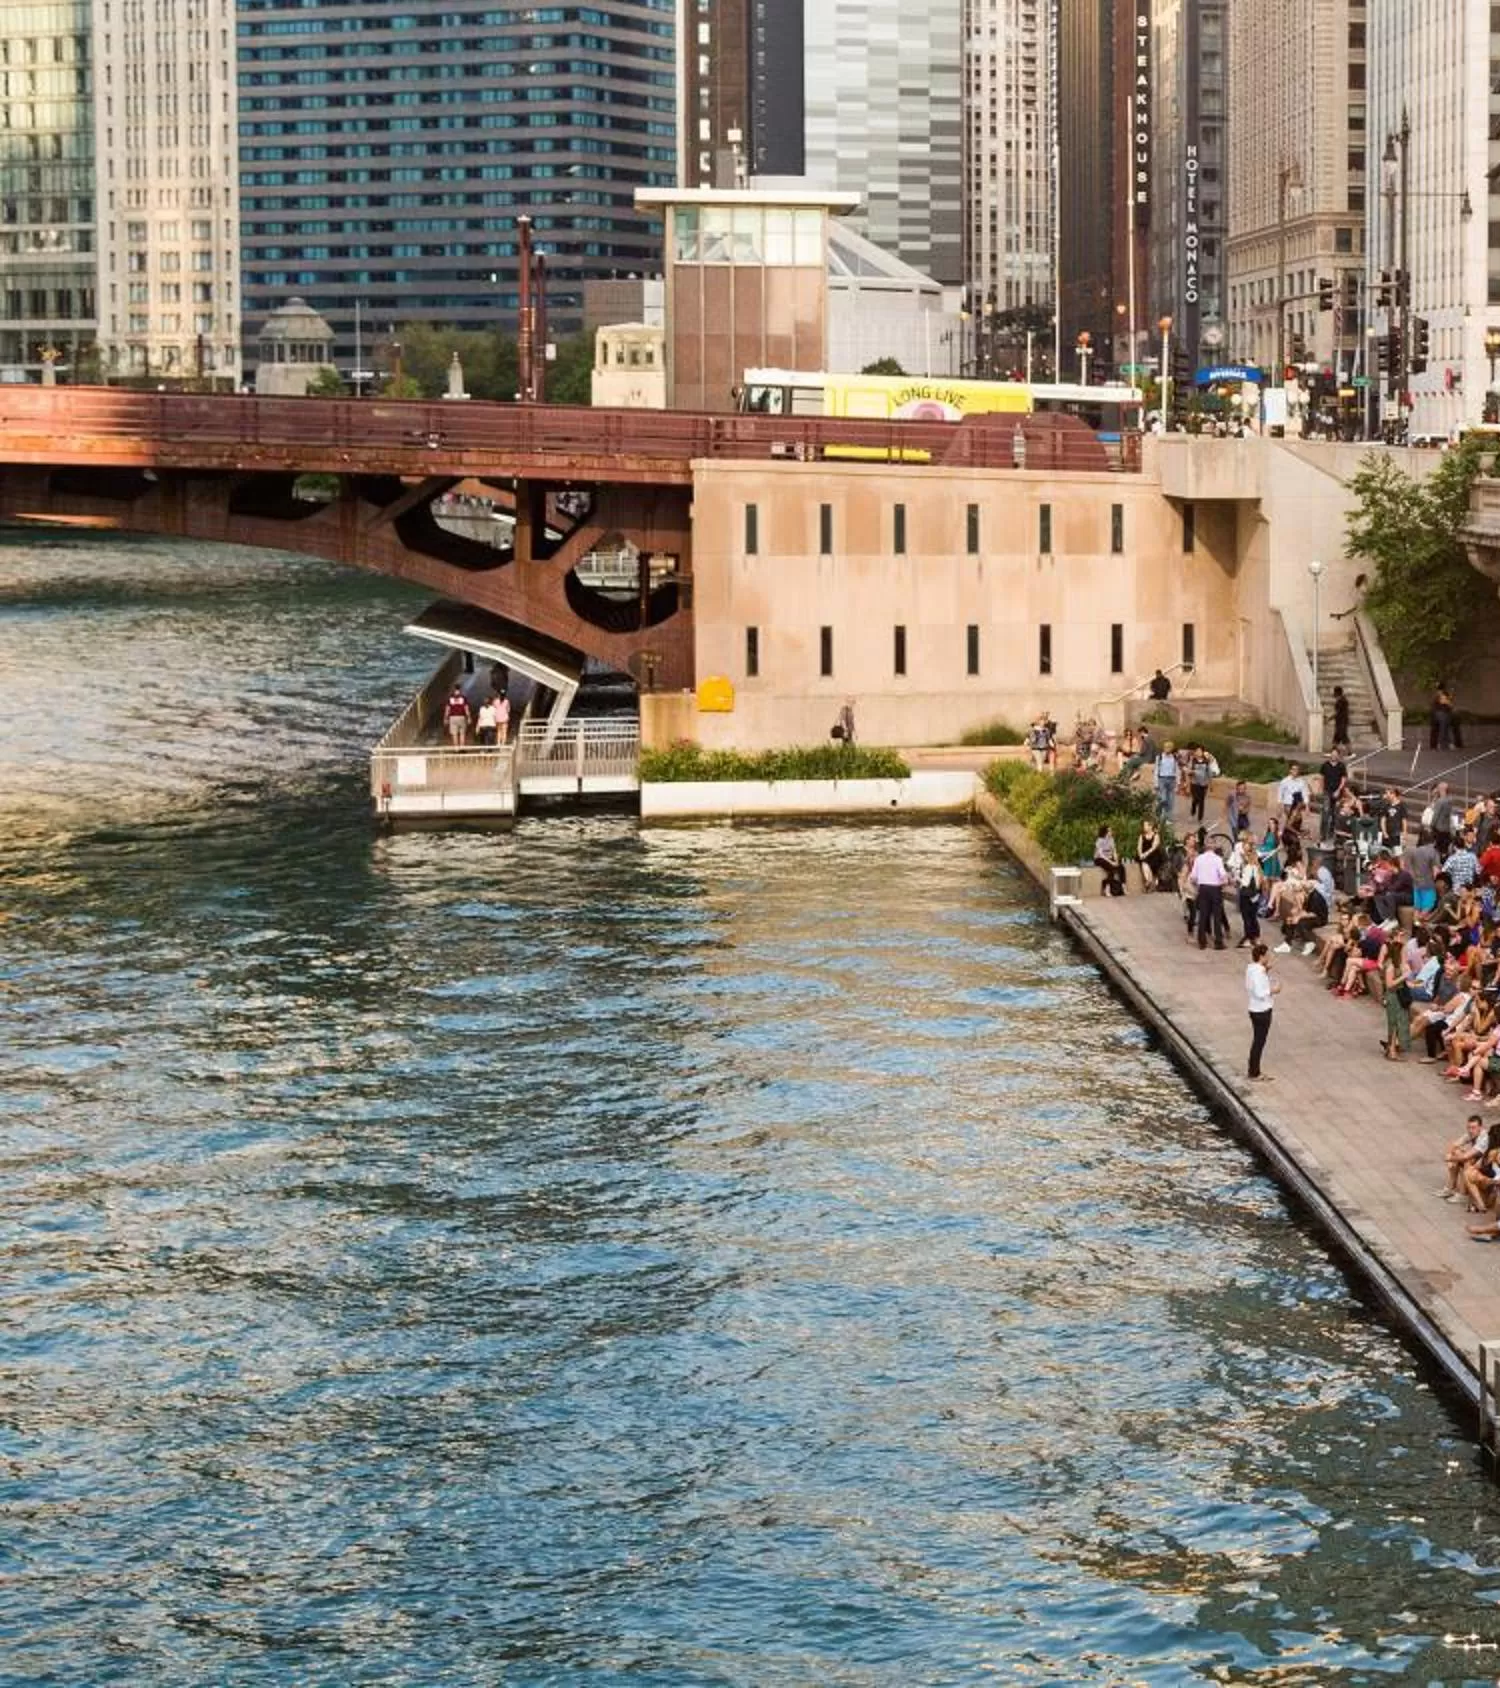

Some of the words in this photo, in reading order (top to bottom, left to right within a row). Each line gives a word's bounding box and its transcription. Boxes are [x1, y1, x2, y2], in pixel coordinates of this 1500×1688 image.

[1137, 15, 1148, 203] STEAKHOUSE
[1185, 145, 1198, 213] HOTEL
[1185, 221, 1198, 303] MONACO
[892, 385, 931, 407] LONG
[935, 388, 967, 410] LIVE
